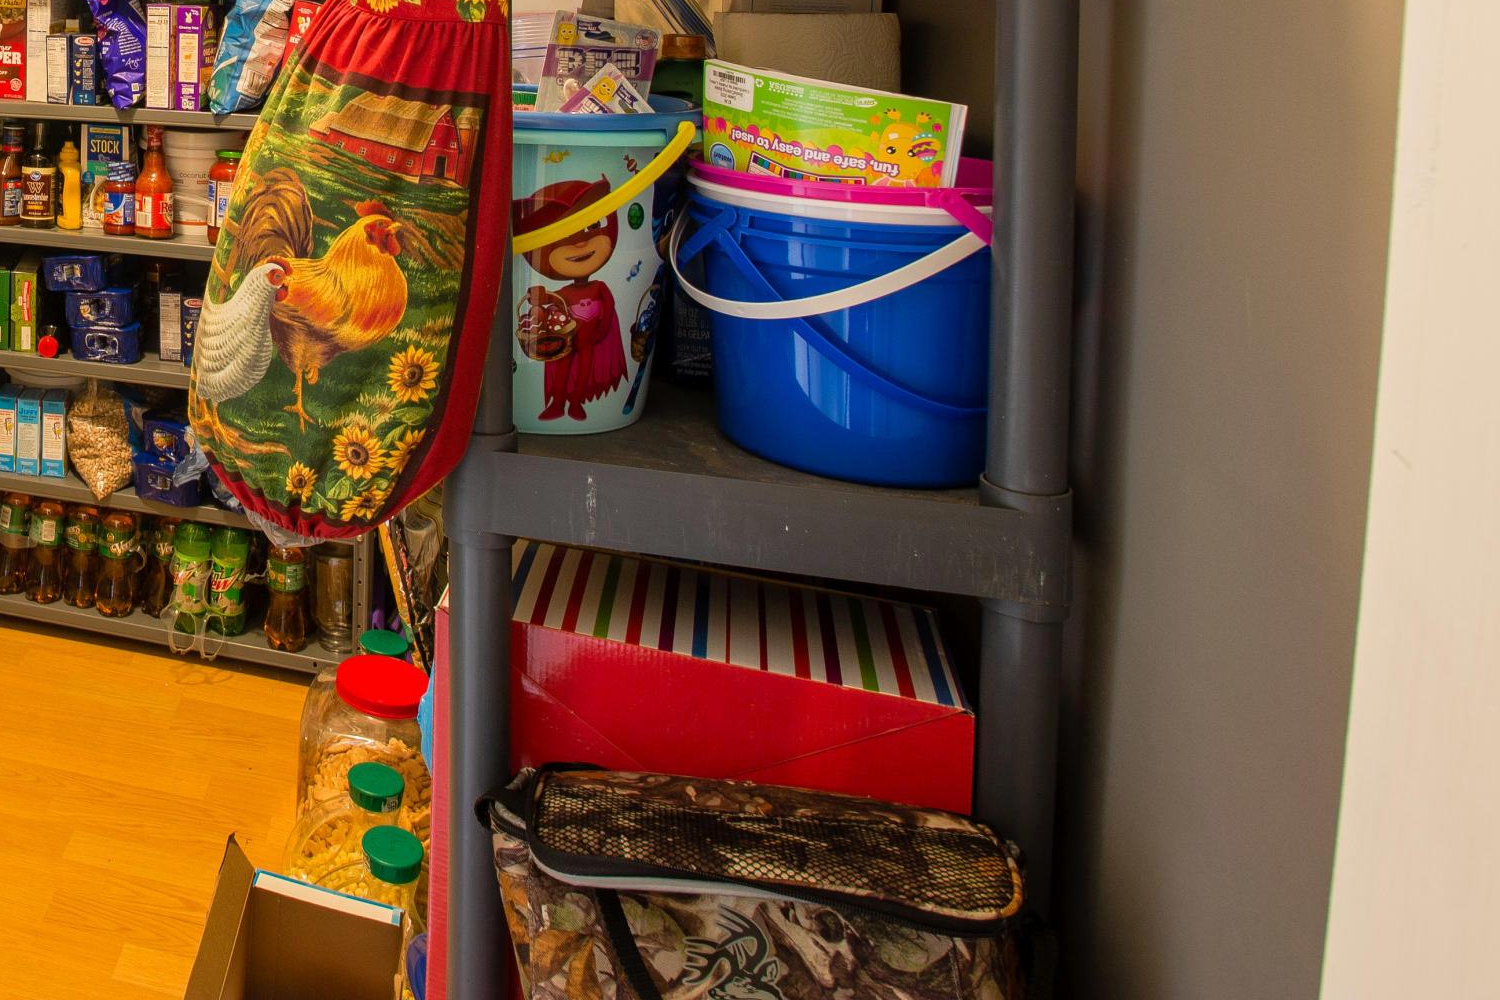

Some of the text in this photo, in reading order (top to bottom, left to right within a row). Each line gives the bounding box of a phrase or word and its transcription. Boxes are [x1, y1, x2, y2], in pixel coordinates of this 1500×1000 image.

[90, 140, 120, 154] STOCK
[731, 128, 900, 176] fun, safe and easy to use!
